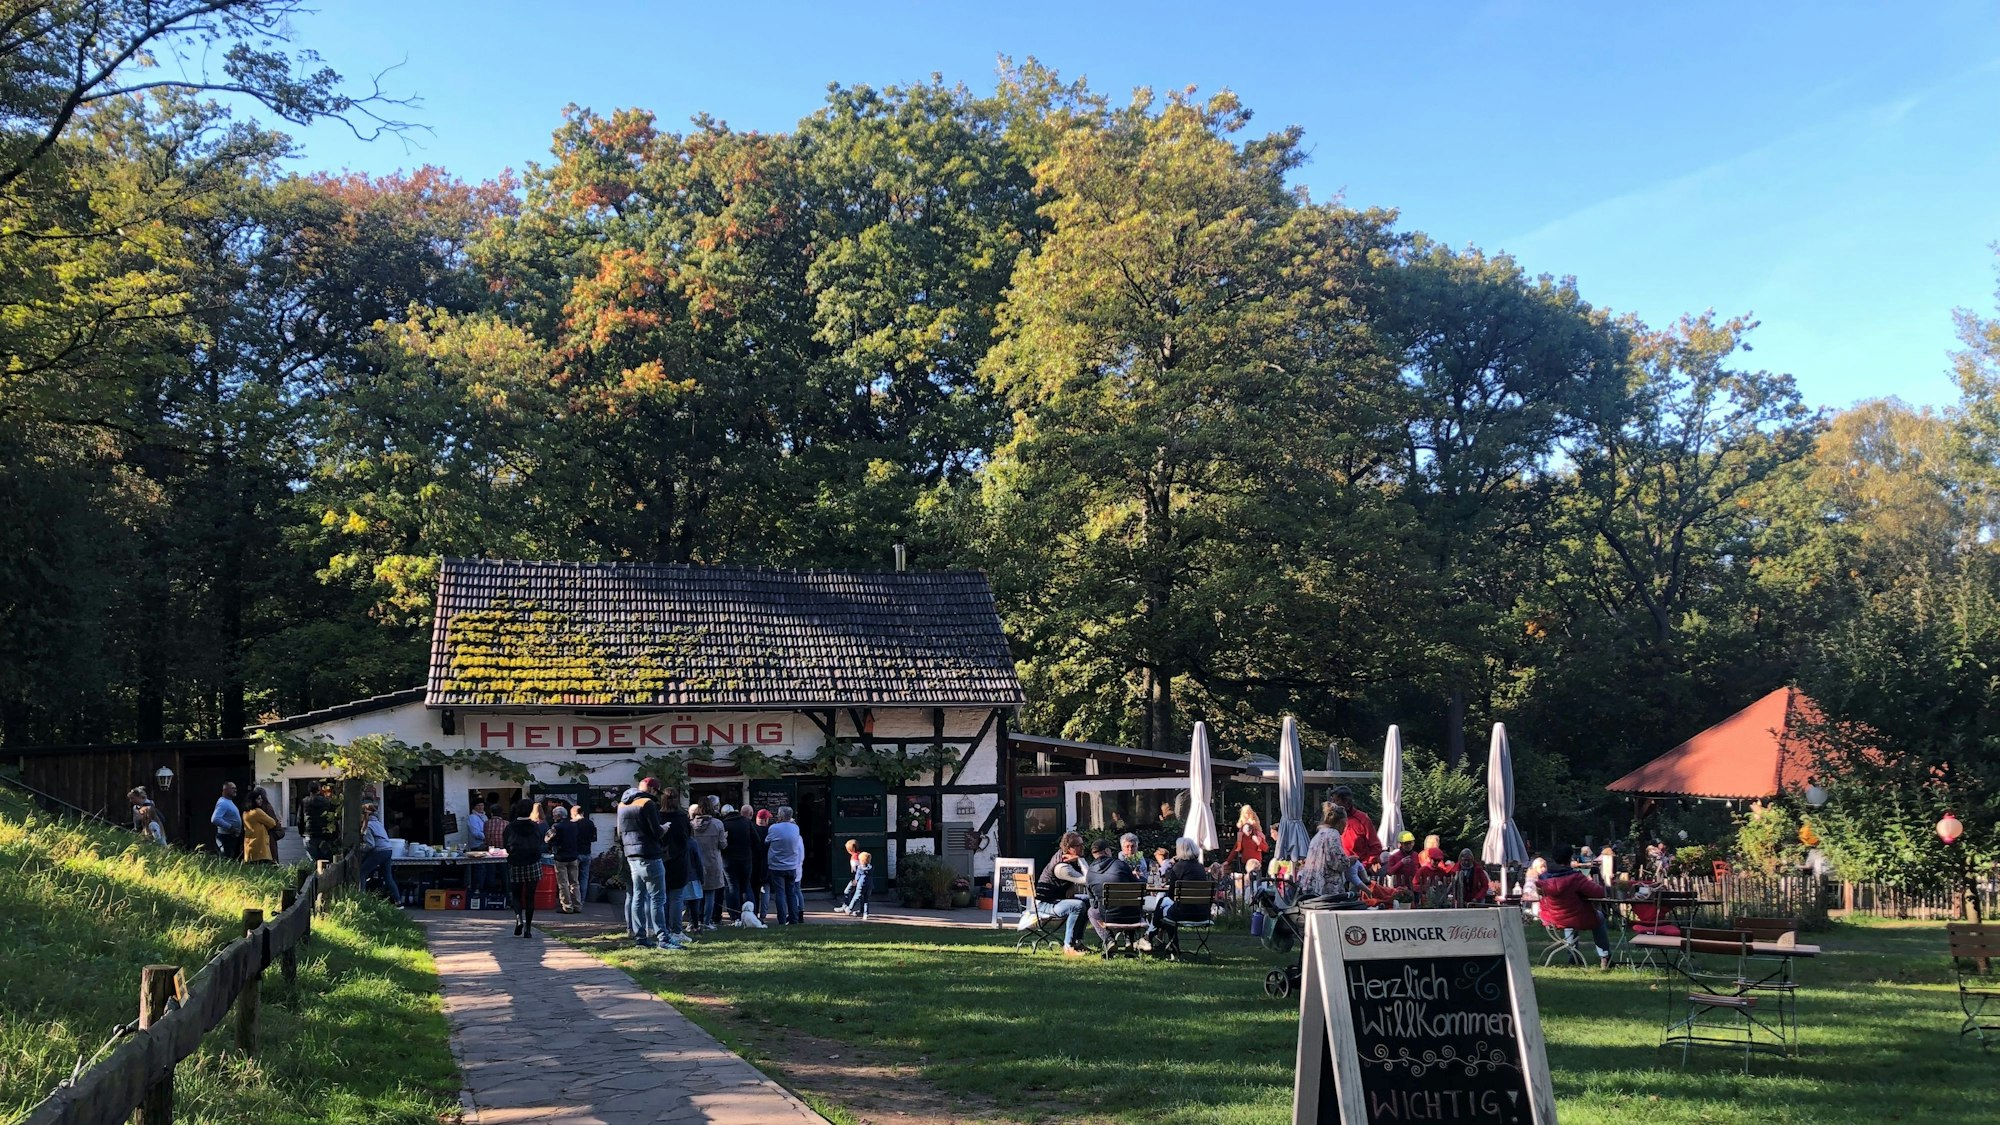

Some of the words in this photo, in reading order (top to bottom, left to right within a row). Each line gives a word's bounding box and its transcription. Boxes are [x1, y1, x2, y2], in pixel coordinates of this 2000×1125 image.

[480, 715, 784, 748] HEIDEKÖNIG
[1372, 927, 1447, 943] ERDINGER
[1447, 925, 1498, 944] Weißbier
[1348, 962, 1449, 1000] Herzlich
